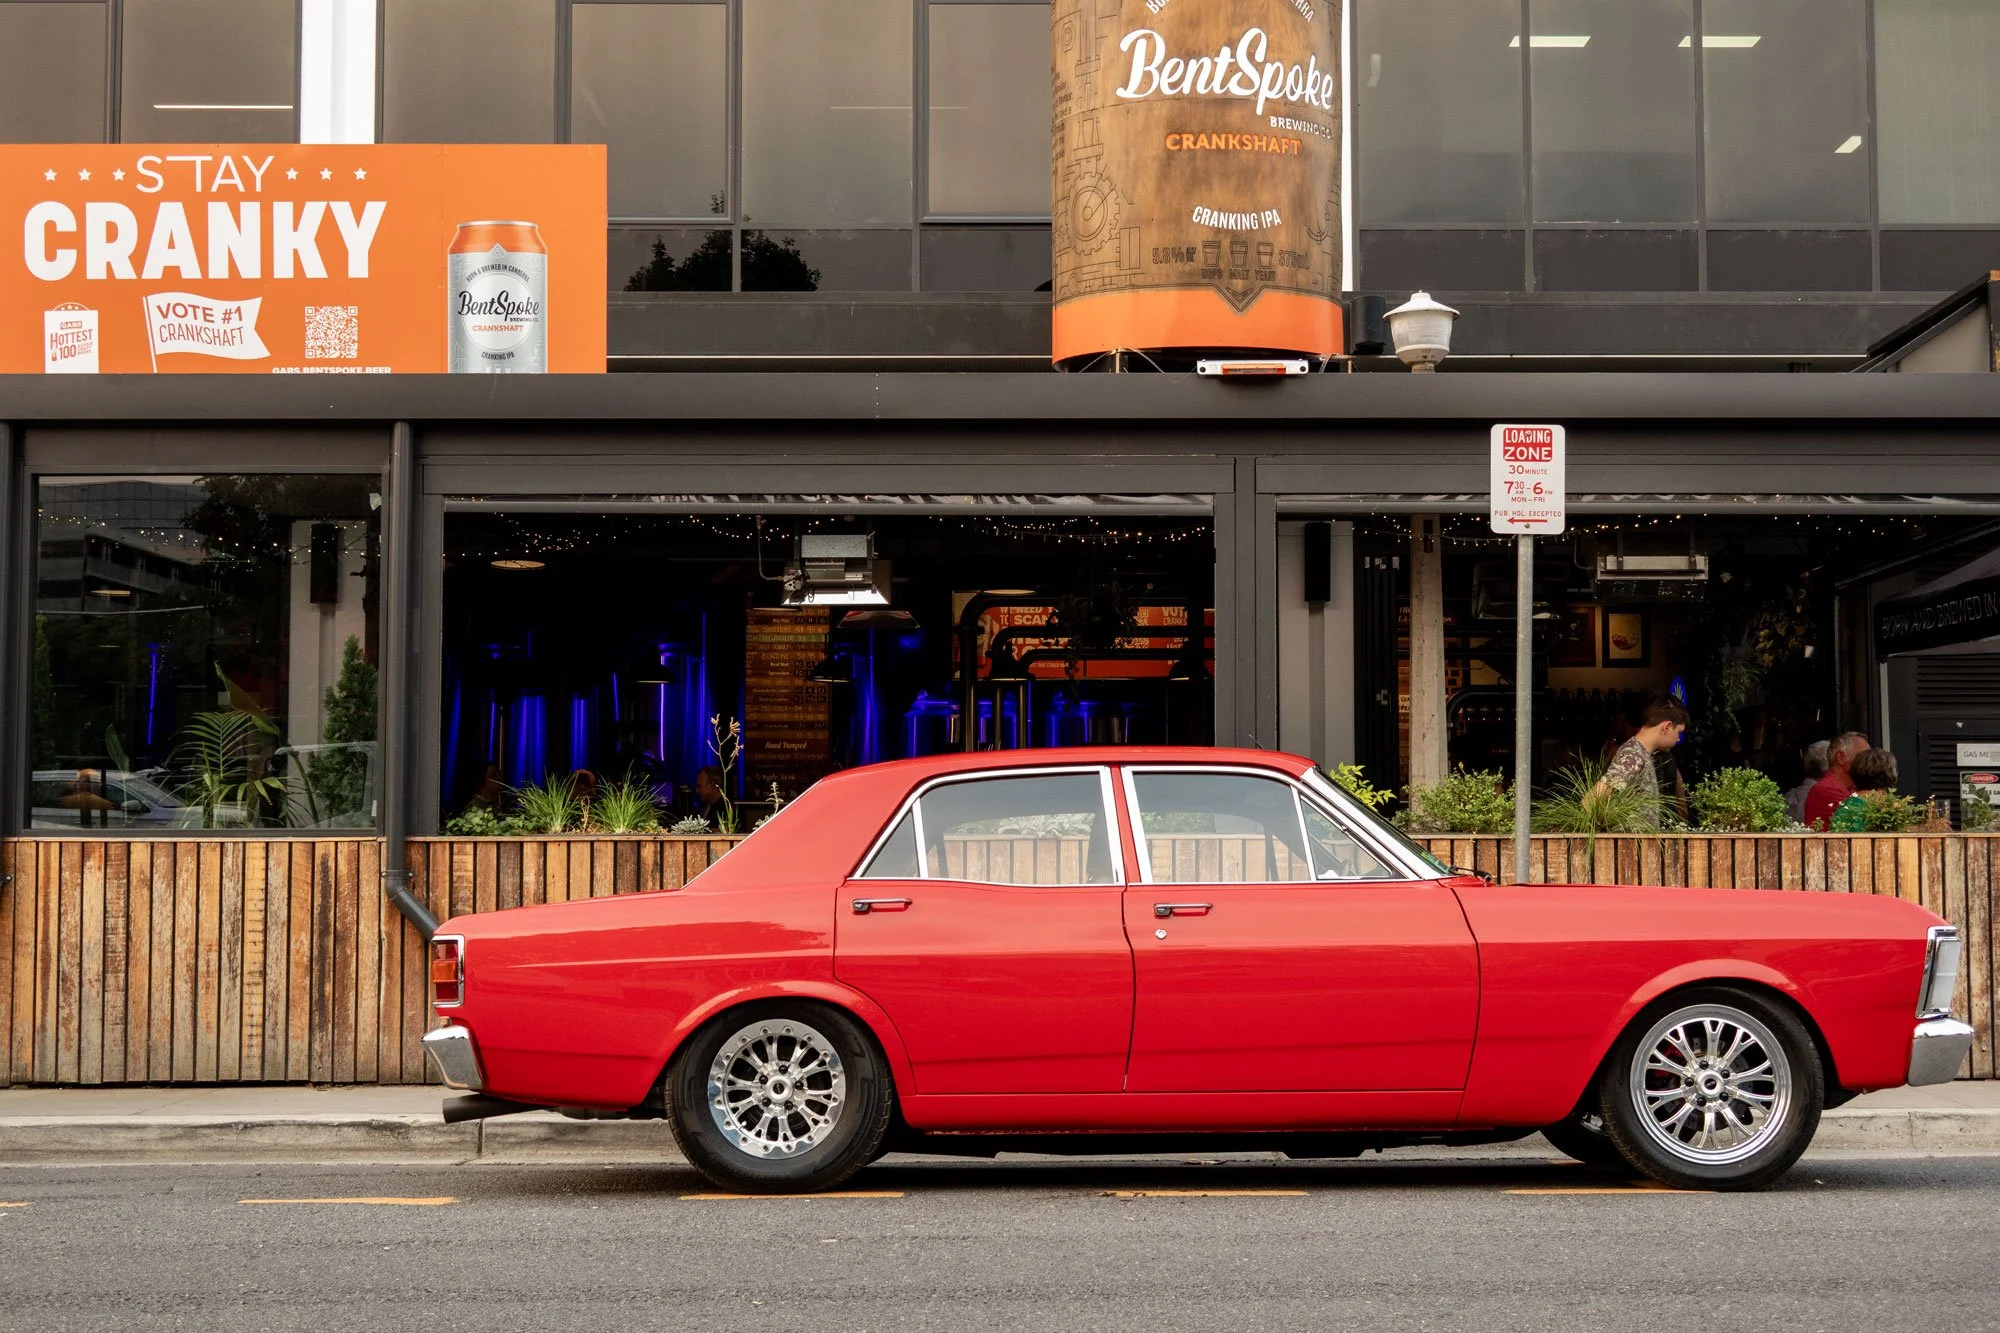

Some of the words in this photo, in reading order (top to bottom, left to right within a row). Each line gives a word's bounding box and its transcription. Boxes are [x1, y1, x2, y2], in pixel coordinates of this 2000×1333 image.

[1116, 28, 1333, 116] BentSpoke
[1270, 116, 1320, 134] BREWING
[1166, 133, 1302, 156] CRANKSHAFT
[136, 155, 274, 193] STAY
[1192, 206, 1258, 230] CRANKING
[1261, 208, 1282, 228] IPA
[24, 201, 387, 281] CRANKY
[157, 302, 214, 324] VOTE
[222, 306, 243, 324] #1
[458, 290, 540, 322] BentSpoke
[50, 329, 93, 350] HOTTEST
[160, 323, 244, 346] CRANKSHAFT
[59, 345, 76, 360] 100
[1505, 430, 1550, 444] LOADING
[1504, 447, 1551, 460] ZONE
[1509, 465, 1524, 474] 30
[1533, 482, 1543, 494] 6
[1882, 614, 1910, 638] BORN
[1911, 608, 1936, 632] AND
[1936, 596, 1982, 627] BREWED
[1984, 592, 1998, 617] IN
[783, 742, 807, 751] Pumped
